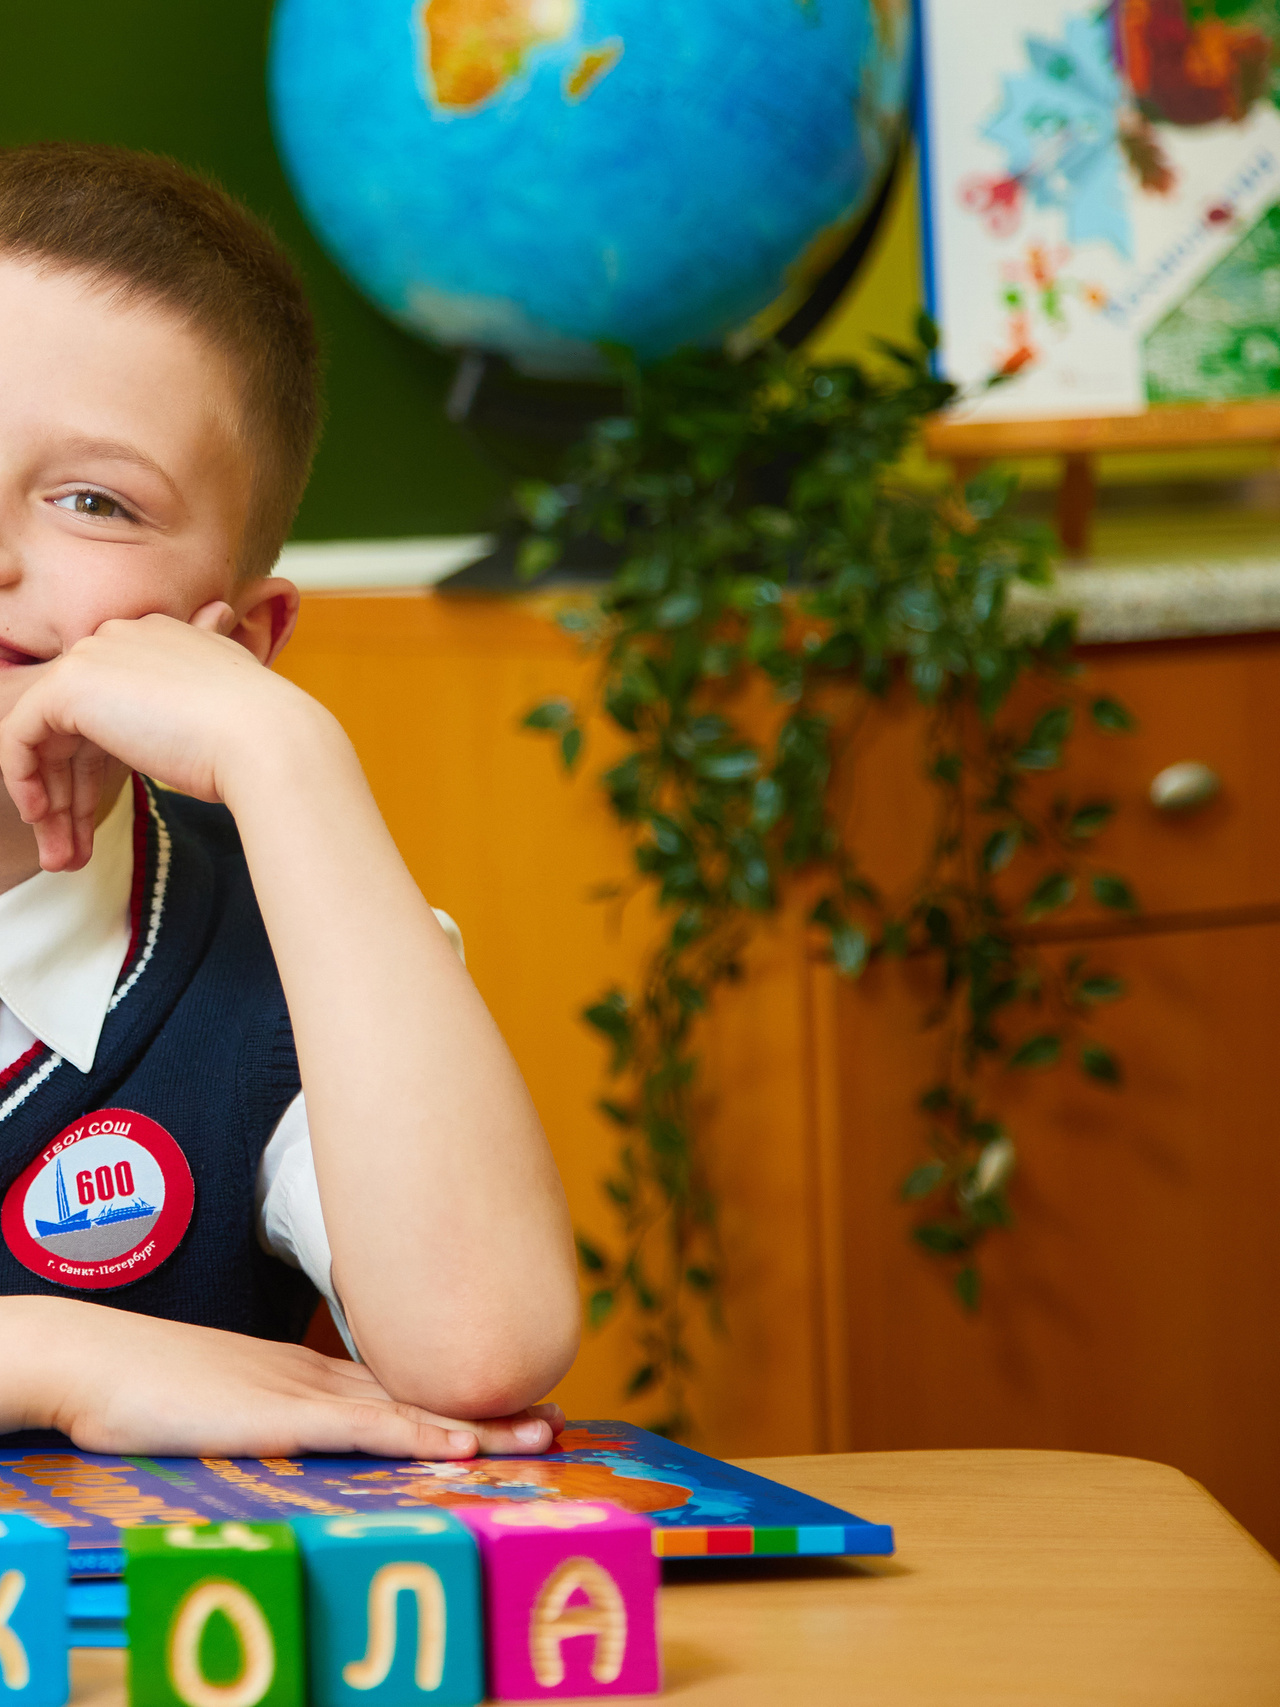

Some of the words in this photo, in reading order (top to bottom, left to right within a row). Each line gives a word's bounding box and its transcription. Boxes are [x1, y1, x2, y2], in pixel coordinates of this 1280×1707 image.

[42, 1127, 84, 1163] ГБОУ
[87, 1120, 132, 1136] СОШ
[75, 1160, 136, 1206] 600
[46, 1259, 56, 1269] г.
[59, 1240, 157, 1277] Санкт-Петербург
[0, 1453, 212, 1529] словарь
